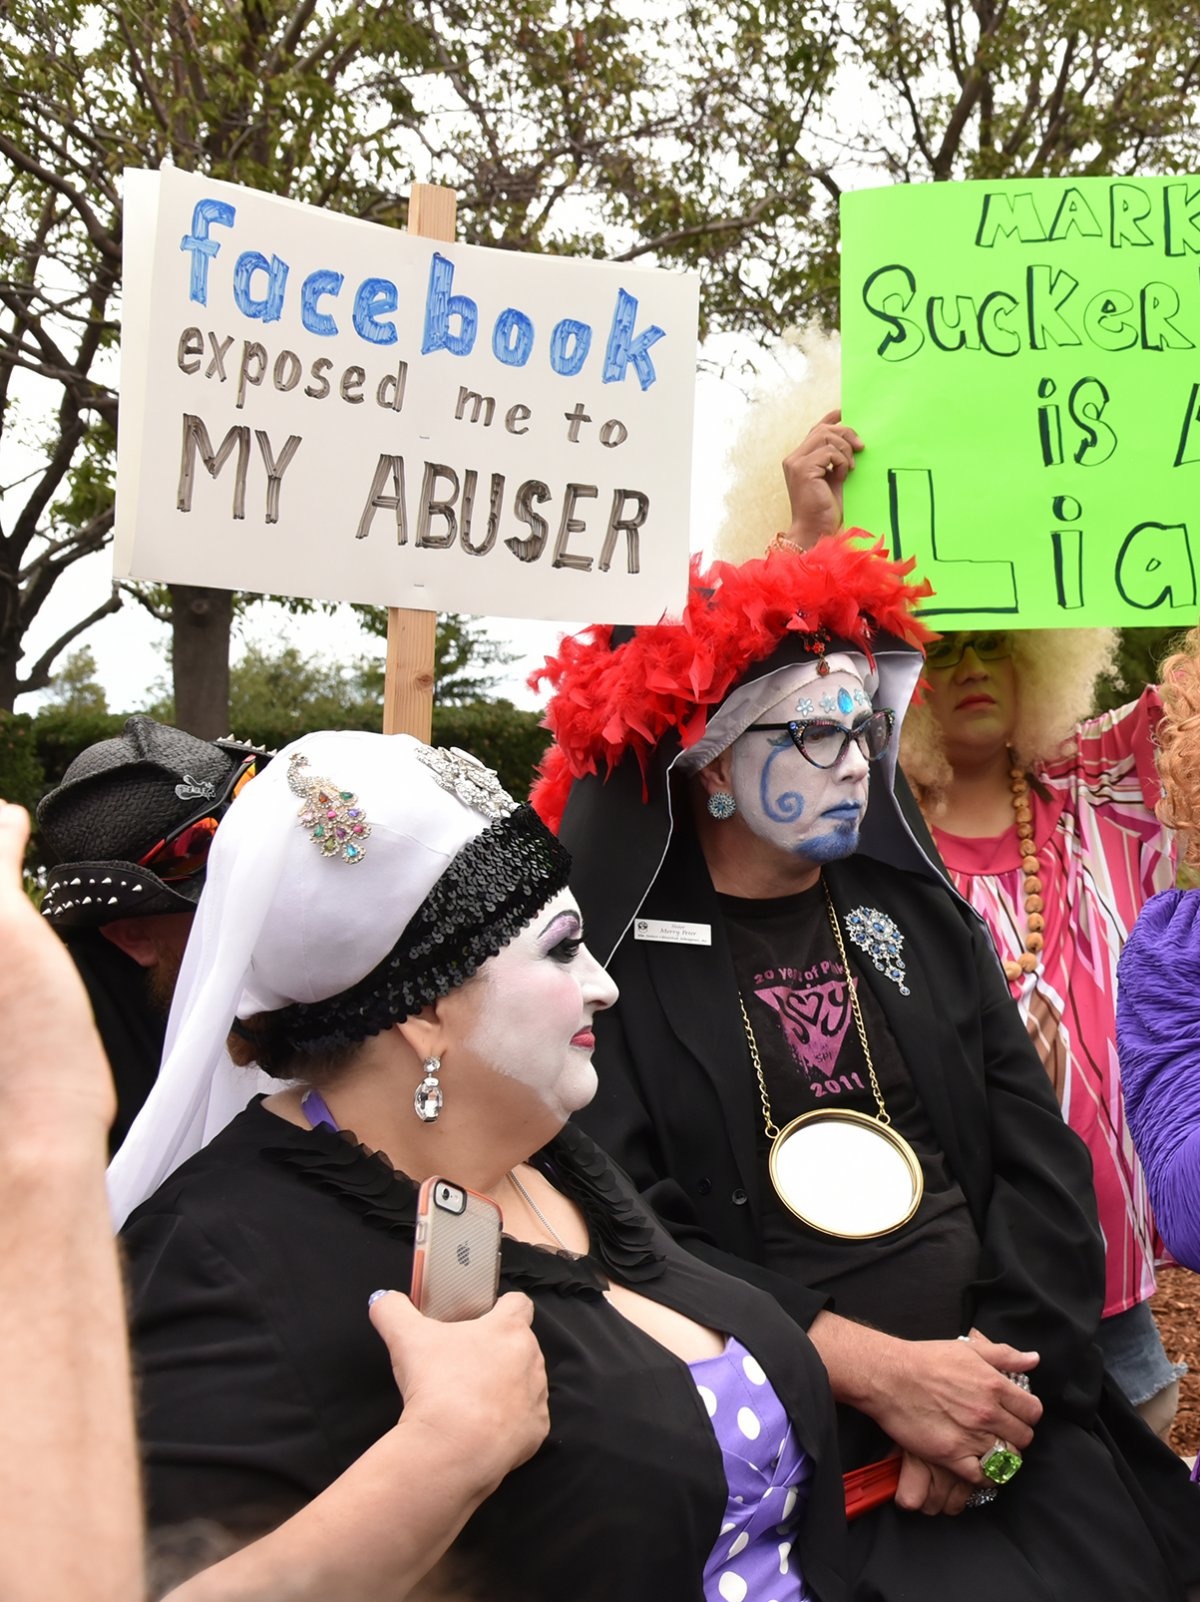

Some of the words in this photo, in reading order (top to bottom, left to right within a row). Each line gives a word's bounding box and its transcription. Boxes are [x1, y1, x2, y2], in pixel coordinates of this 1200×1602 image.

[180, 197, 667, 391] facebook
[177, 326, 407, 412] exposed
[455, 385, 532, 435] me
[565, 403, 628, 448] to
[176, 413, 302, 524] MY
[355, 453, 650, 574] ABUSER
[804, 965, 819, 980] of
[810, 1072, 865, 1098] 2011
